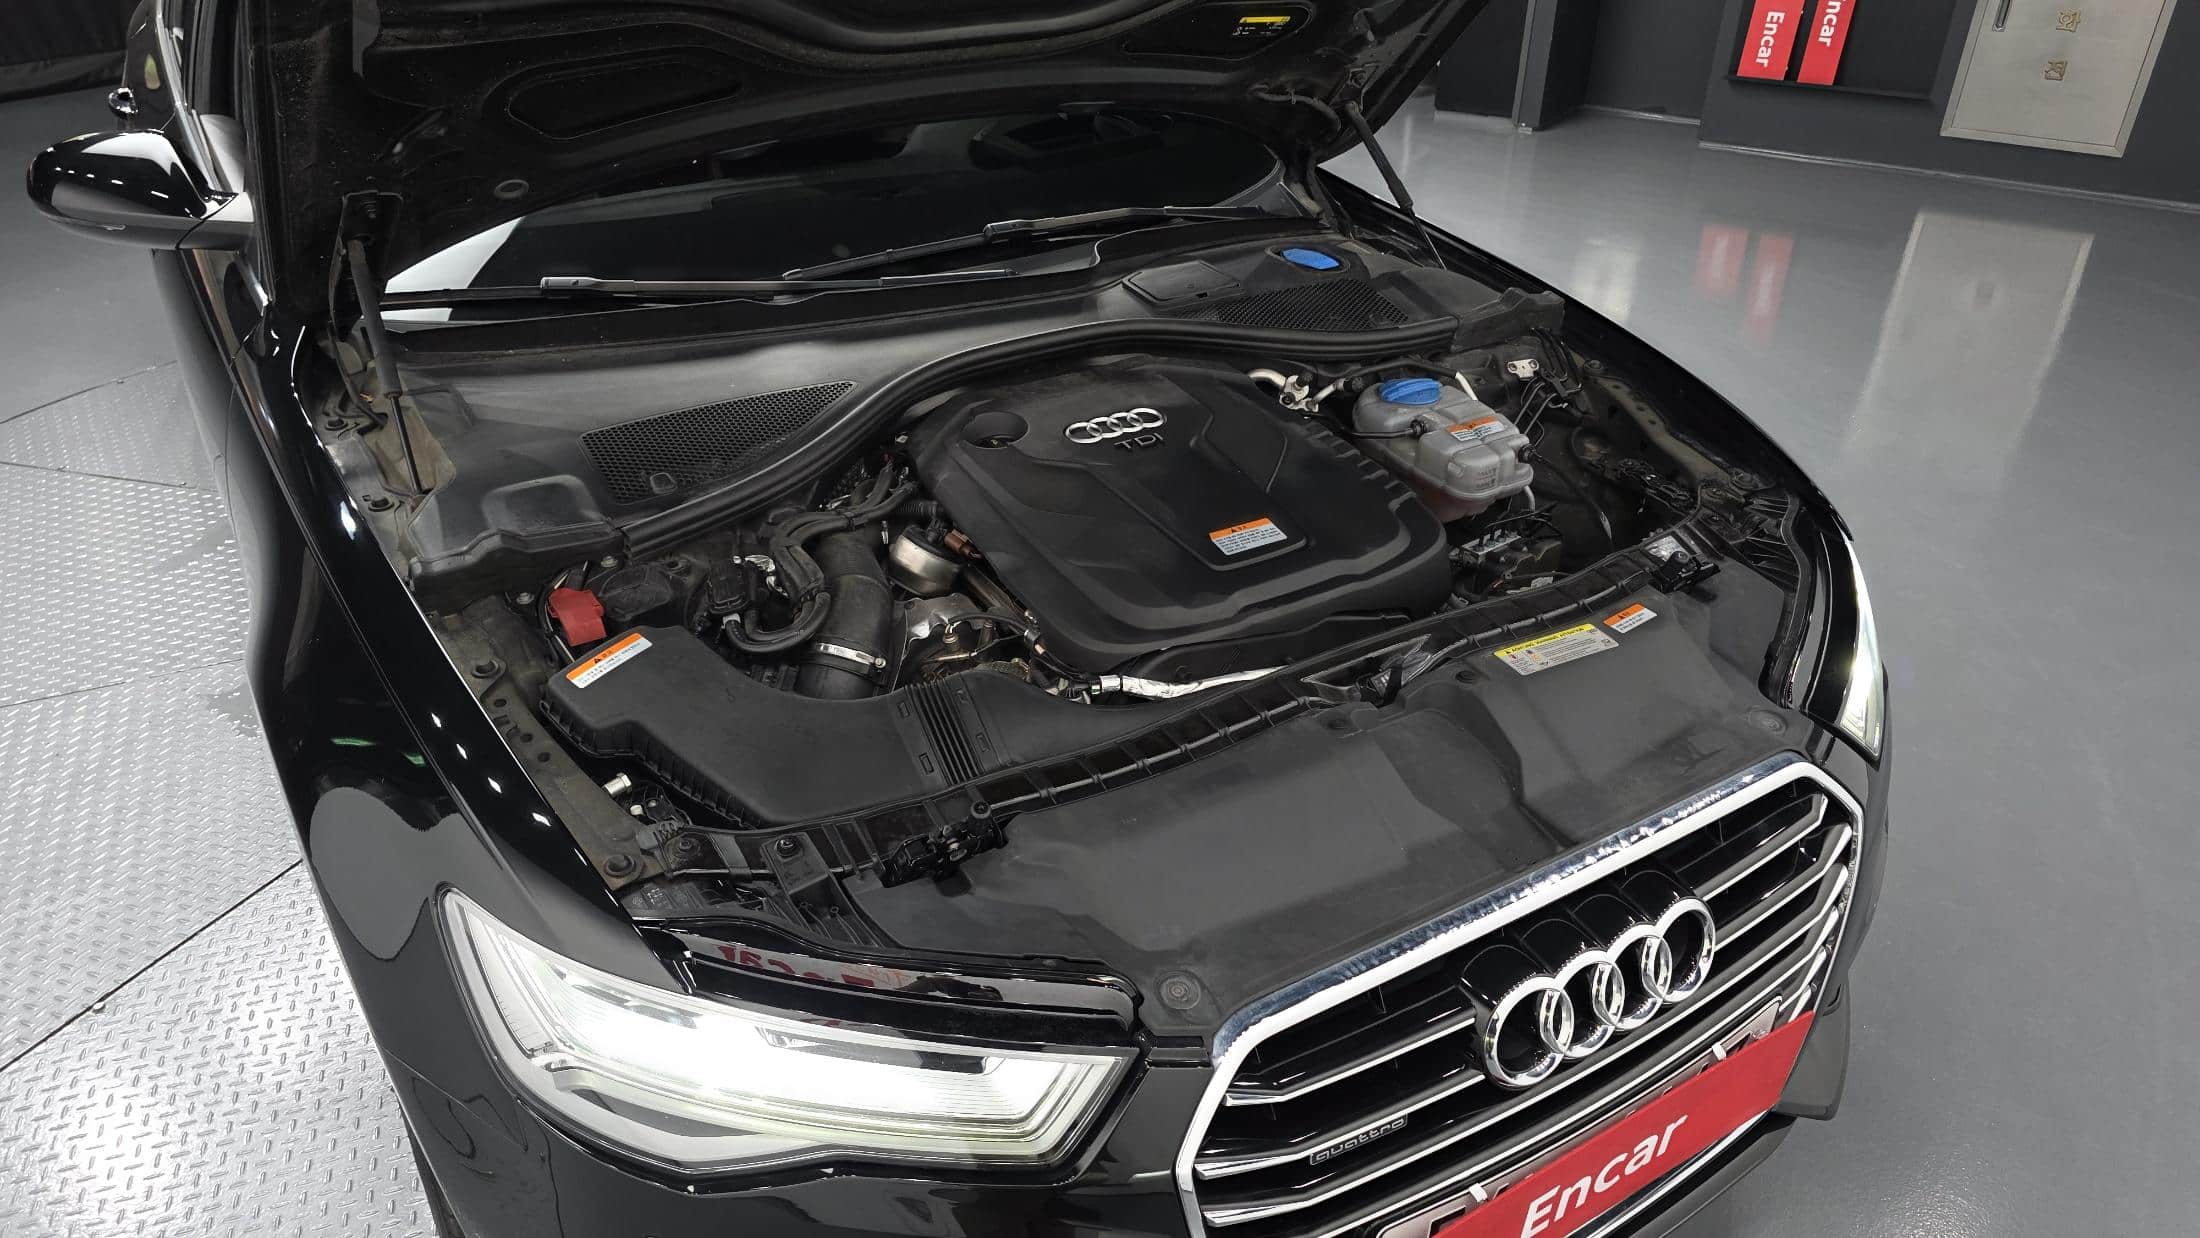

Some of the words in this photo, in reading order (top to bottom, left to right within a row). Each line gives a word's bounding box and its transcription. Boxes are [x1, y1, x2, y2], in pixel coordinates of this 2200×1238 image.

[1756, 11, 1785, 68] Encar
[1818, 0, 1845, 47] ncar
[1113, 432, 1164, 449] TDI
[1315, 1118, 1405, 1161] quattro
[1520, 1114, 1689, 1238] Encar
